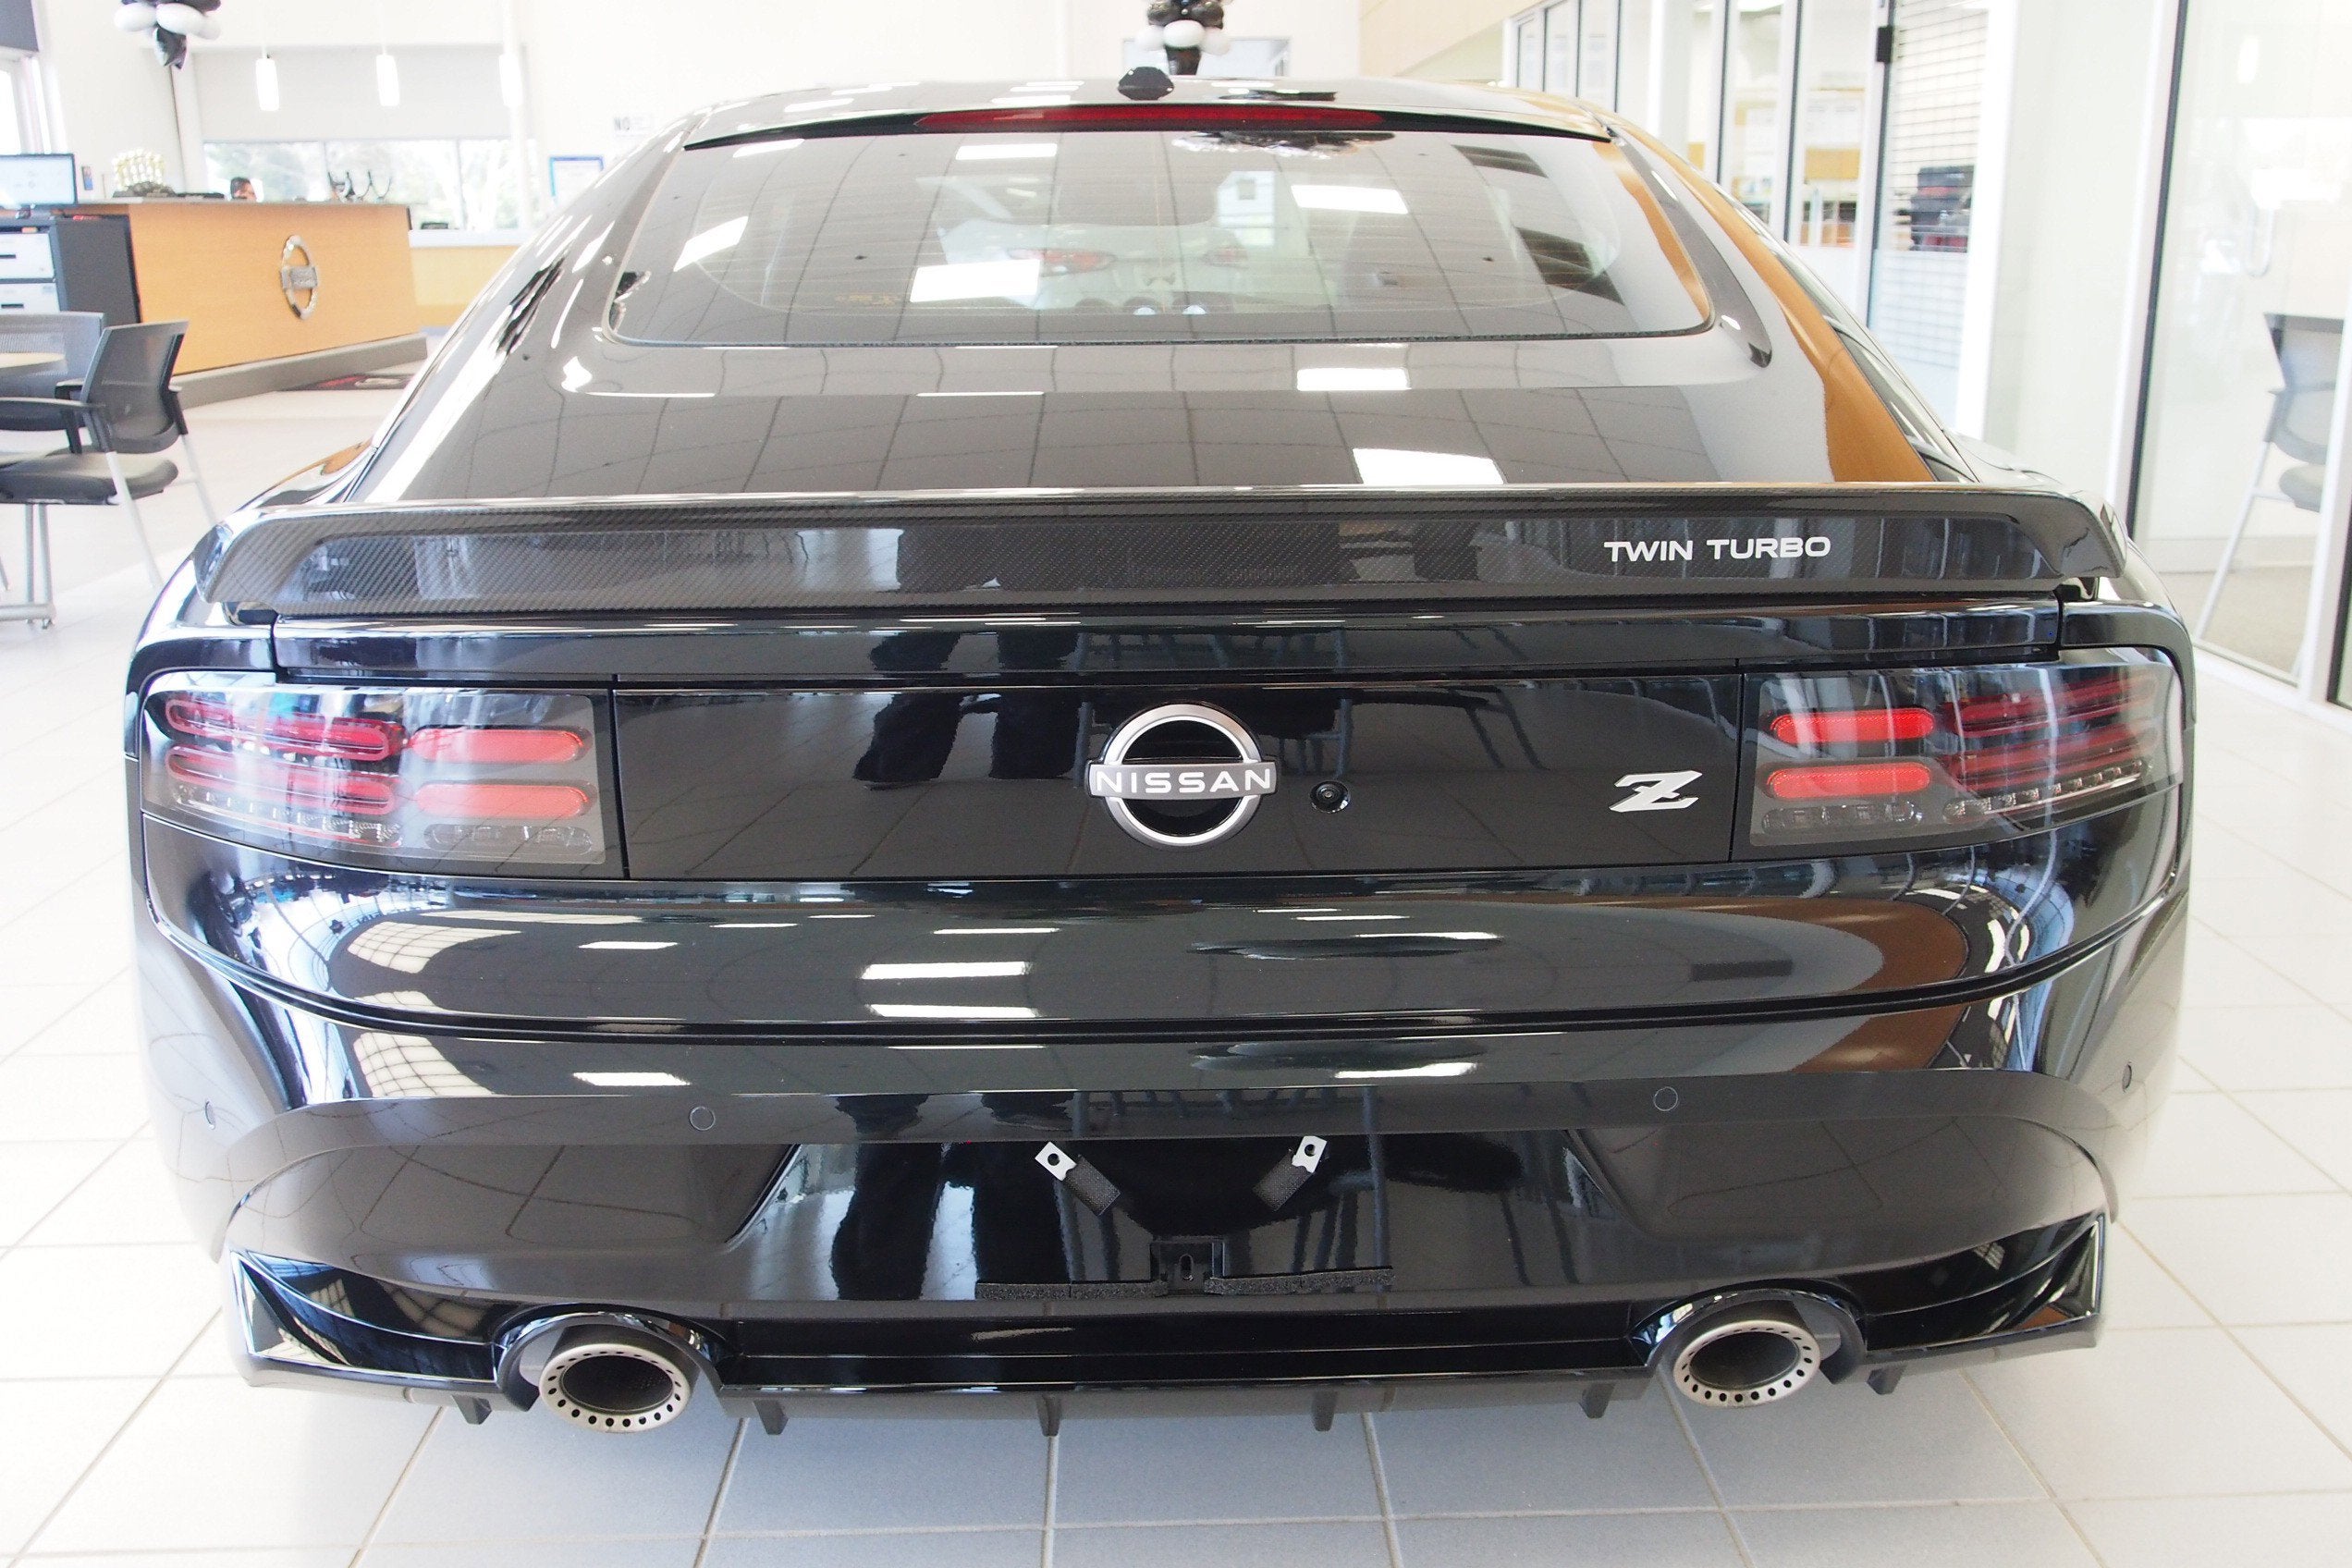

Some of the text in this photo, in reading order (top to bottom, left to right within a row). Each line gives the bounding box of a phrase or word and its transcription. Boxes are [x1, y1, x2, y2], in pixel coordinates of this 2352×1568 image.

[1603, 536, 1831, 562] TWIN TURBO
[1096, 768, 1271, 794] NISSAN
[1609, 769, 1703, 813] Z
